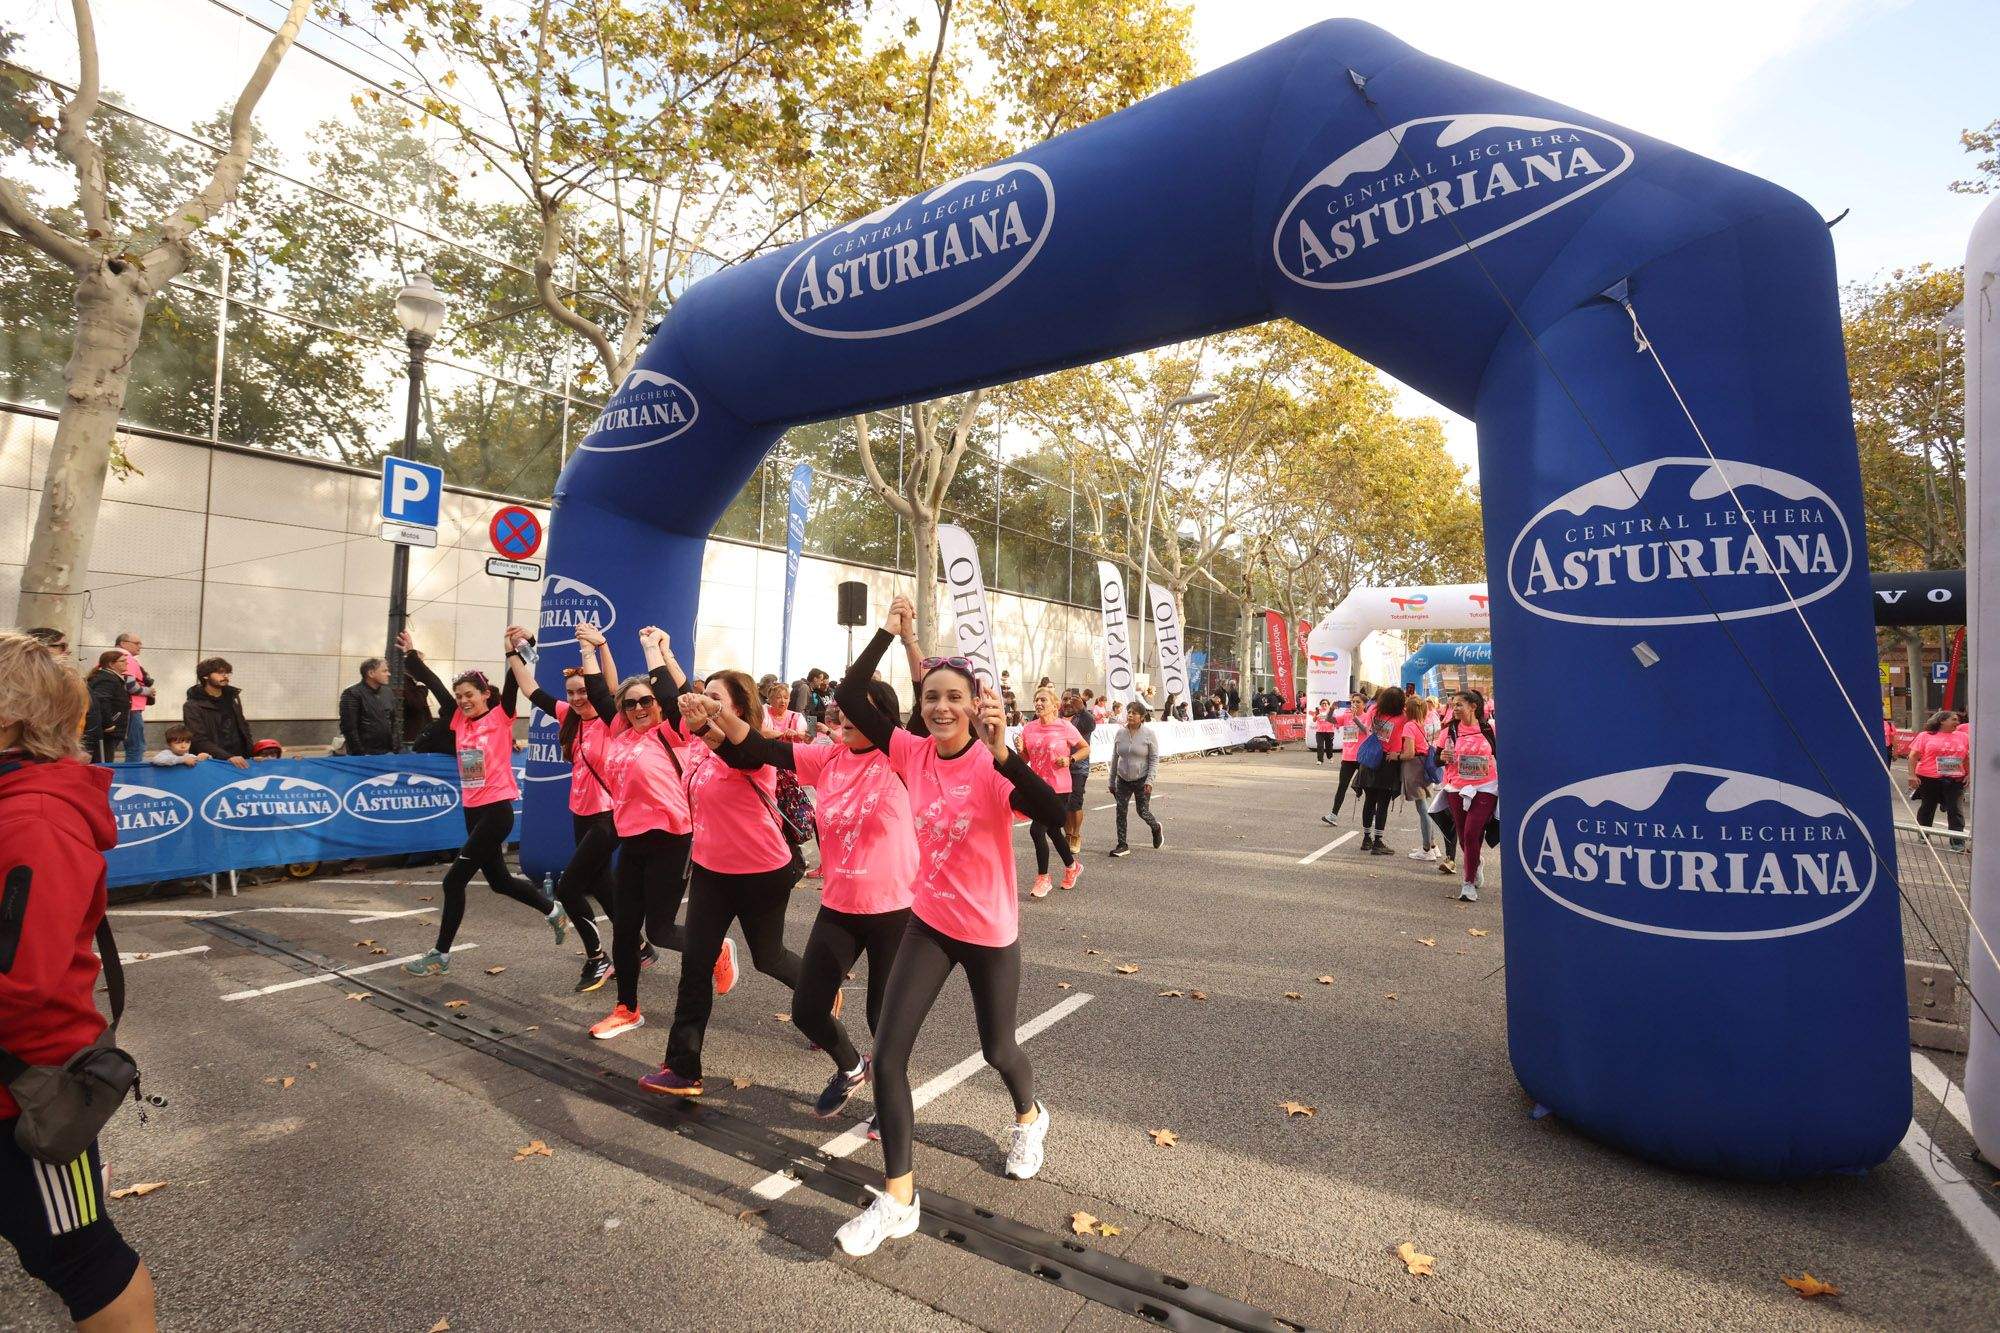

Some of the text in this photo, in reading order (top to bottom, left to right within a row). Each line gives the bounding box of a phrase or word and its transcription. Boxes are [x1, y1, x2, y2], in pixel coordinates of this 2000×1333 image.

[1327, 133, 1582, 215] CENTRAL LECHERA
[833, 178, 1019, 257] CENTRAL LECHERA
[1299, 147, 1606, 277] ASTURIANA
[794, 200, 1031, 315] ASTURIANA
[630, 389, 677, 403] LECHERA
[588, 401, 688, 435] STURIANA
[390, 464, 430, 515] P
[401, 530, 420, 540] Motos
[1565, 508, 1825, 543] CENTRAL LECHERA
[1523, 533, 1838, 597] ASTURIANA
[555, 598, 599, 606] LECHERA
[1875, 588, 1952, 603] VO
[541, 609, 602, 629] URIANA
[284, 791, 328, 799] LECHERA
[353, 791, 452, 812] ASTURIANA
[411, 786, 447, 794] LECHERA
[120, 800, 174, 811] LECHERA
[213, 796, 333, 820] ASTURIANA
[1576, 818, 1847, 842] CENTRAL LECHERA
[1534, 817, 1860, 895] ASTURIANA
